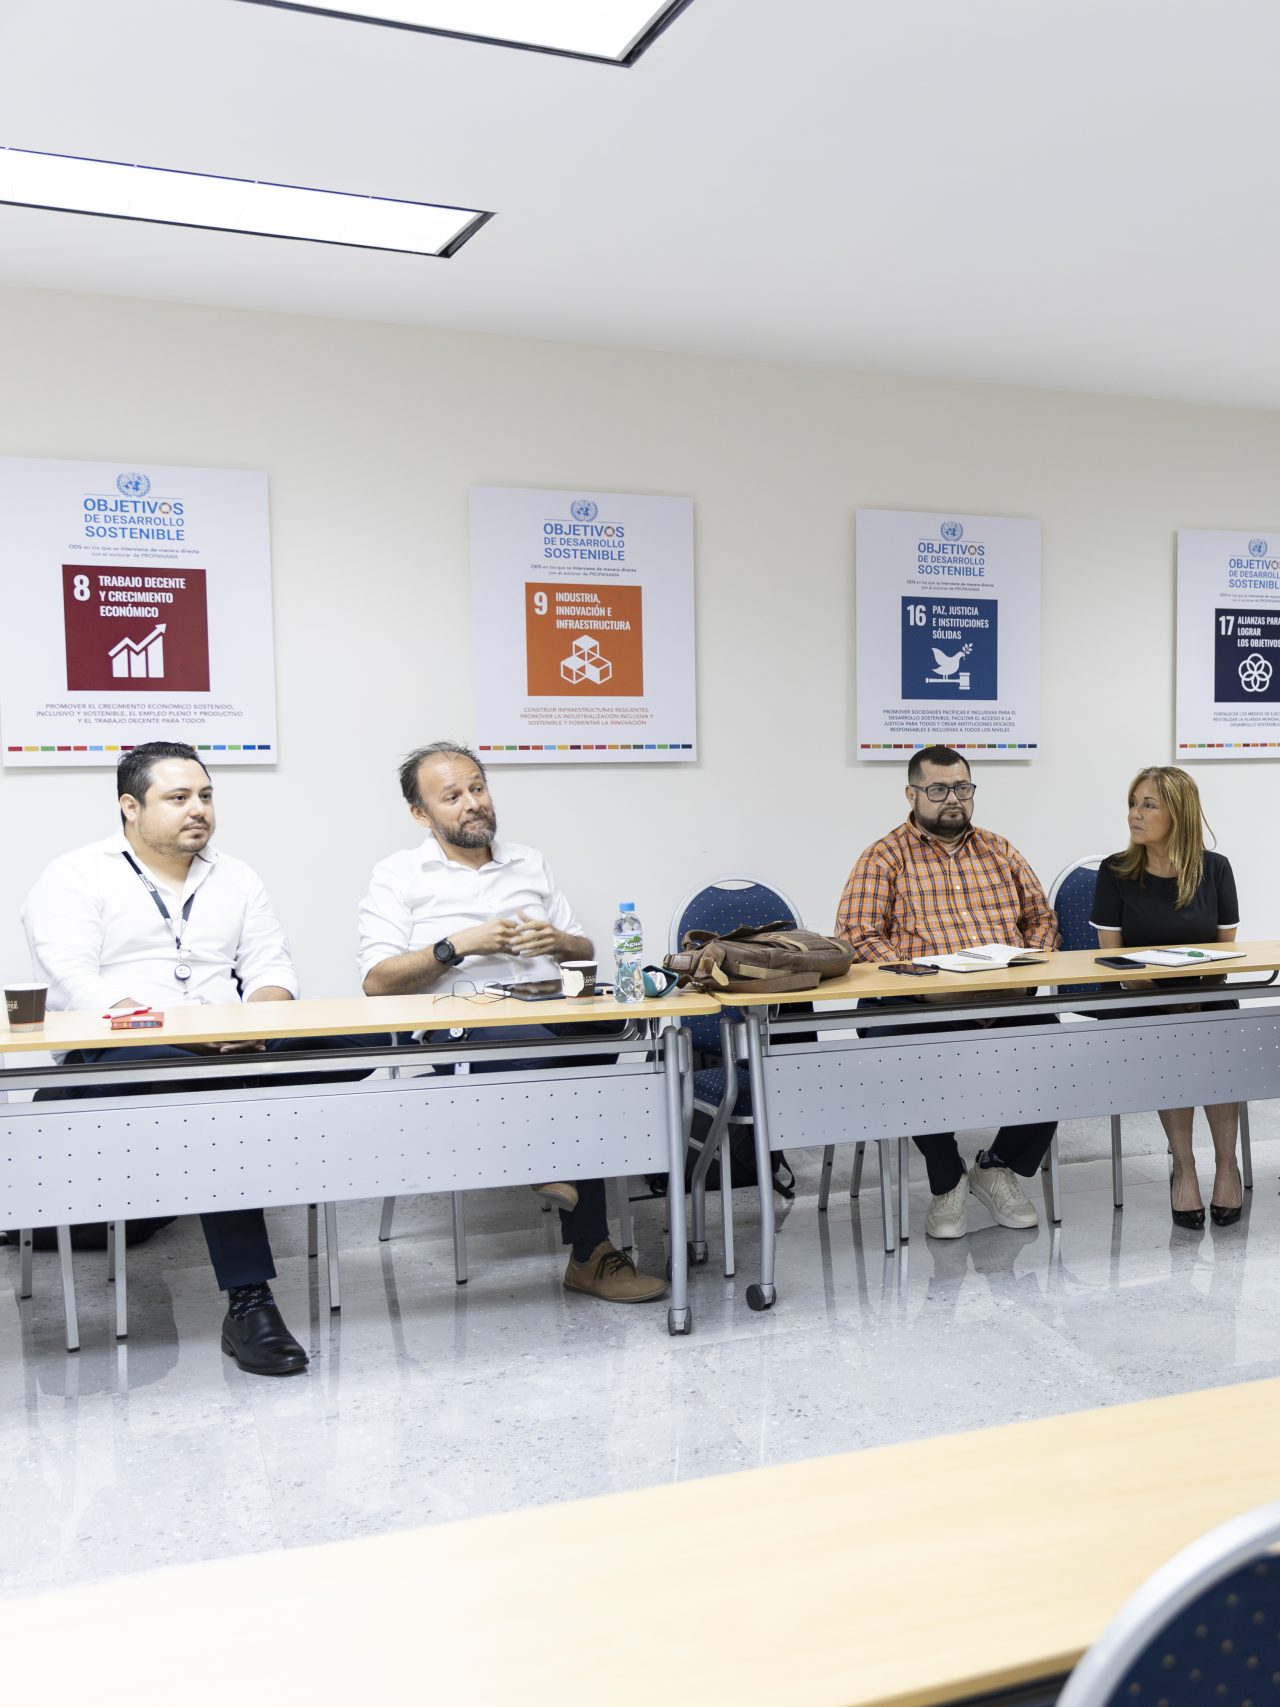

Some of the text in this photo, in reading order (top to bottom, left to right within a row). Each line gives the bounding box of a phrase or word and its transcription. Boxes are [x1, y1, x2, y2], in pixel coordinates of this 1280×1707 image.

[84, 498, 184, 515] OBJETIVOS
[84, 514, 184, 527] DE DESARROLLO
[85, 526, 185, 540] SOSTENIBLE
[544, 523, 624, 538] OBJETIVOS
[544, 537, 625, 548] DE DESARROLLO
[918, 542, 984, 556] OBJETIVOS
[544, 548, 625, 561] SOSTENIBLE
[931, 556, 984, 565] DESARROLLO
[918, 565, 984, 577] SOSTENIBLE
[74, 574, 90, 601] 8
[98, 576, 186, 589] TRABAJO DECENTE
[99, 590, 173, 603] Y CRECIMIENTO
[534, 591, 548, 615] 9
[556, 592, 601, 604] INDUSTRIA,
[100, 603, 159, 617] ECONÓMICO
[556, 604, 612, 616] INNOVACIÓN E
[907, 604, 926, 626] 16
[932, 606, 979, 616] PAZ, JUSTICIA
[556, 620, 631, 630] INFRAESTRUCTURA
[932, 618, 989, 628] E INSTITUCIONES
[1219, 615, 1235, 636] 17
[1237, 616, 1266, 625] ALIANZAS
[932, 628, 962, 640] SÓLIDAS
[1237, 627, 1261, 636] LOGRAR
[1237, 639, 1249, 647] LOS
